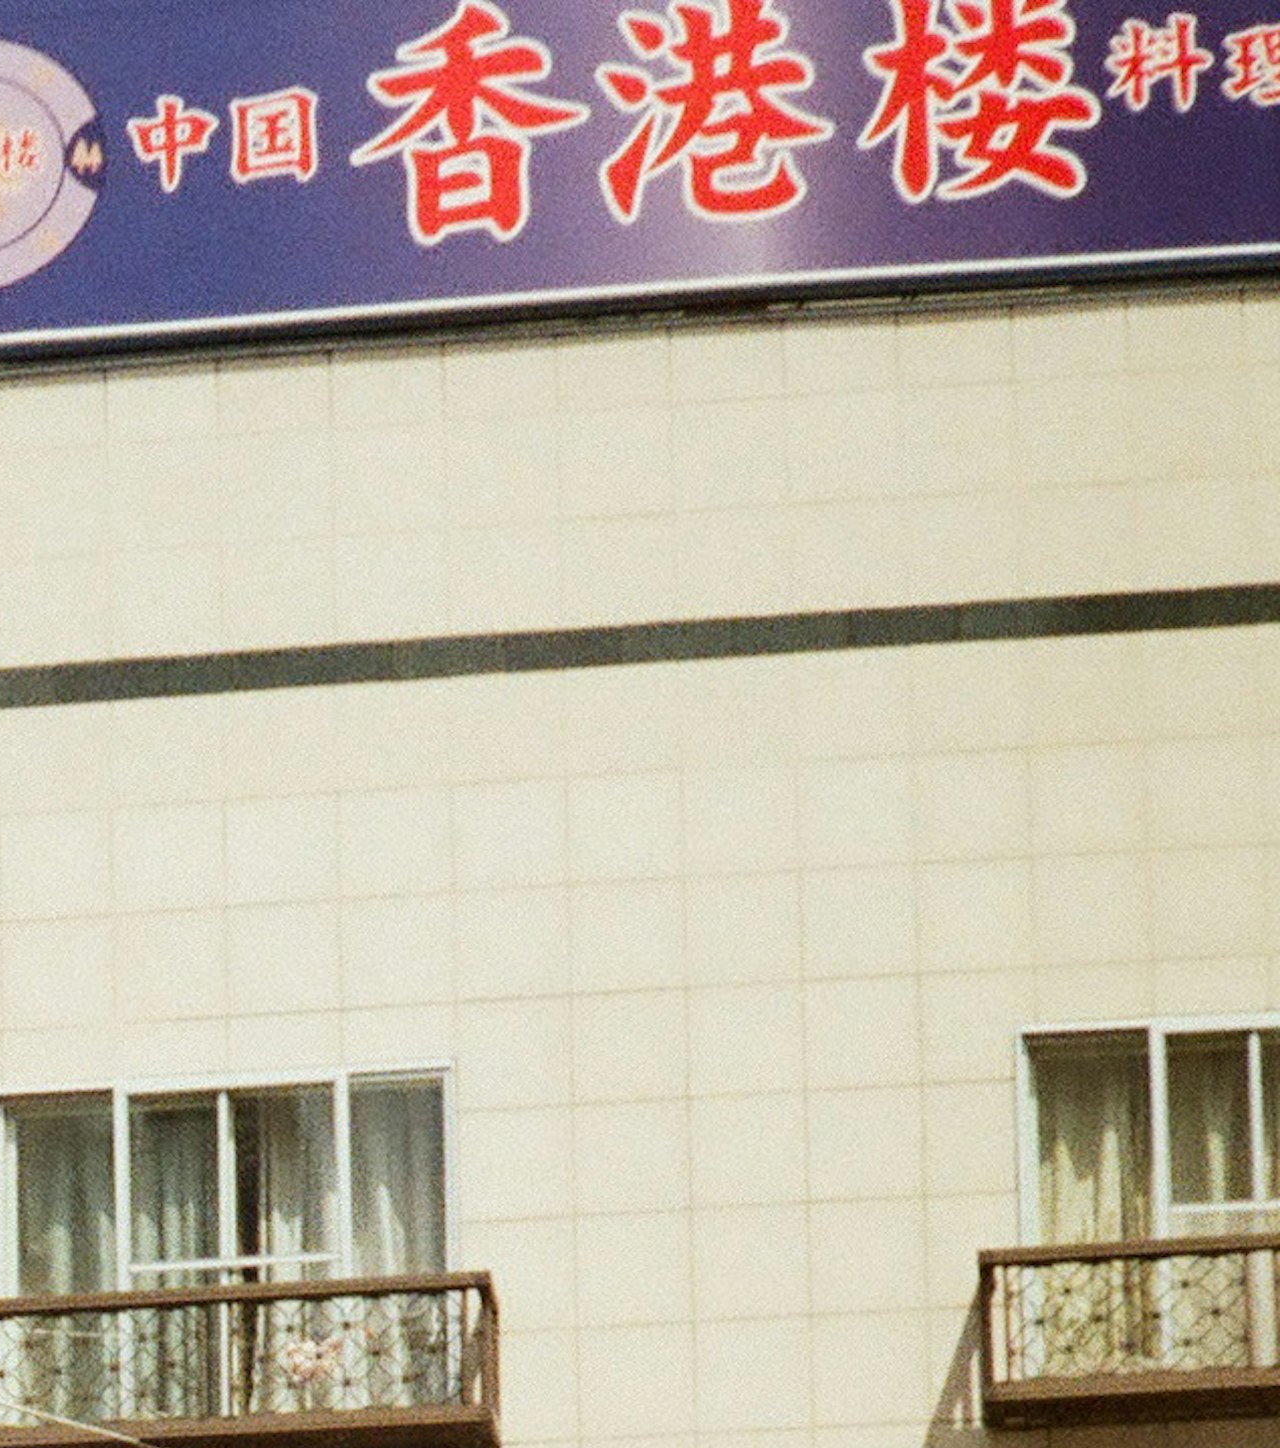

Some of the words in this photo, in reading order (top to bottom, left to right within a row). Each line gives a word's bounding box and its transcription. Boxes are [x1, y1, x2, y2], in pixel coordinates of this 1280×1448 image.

[127, 85, 319, 194] 中国
[348, 0, 1102, 245] 香港楼
